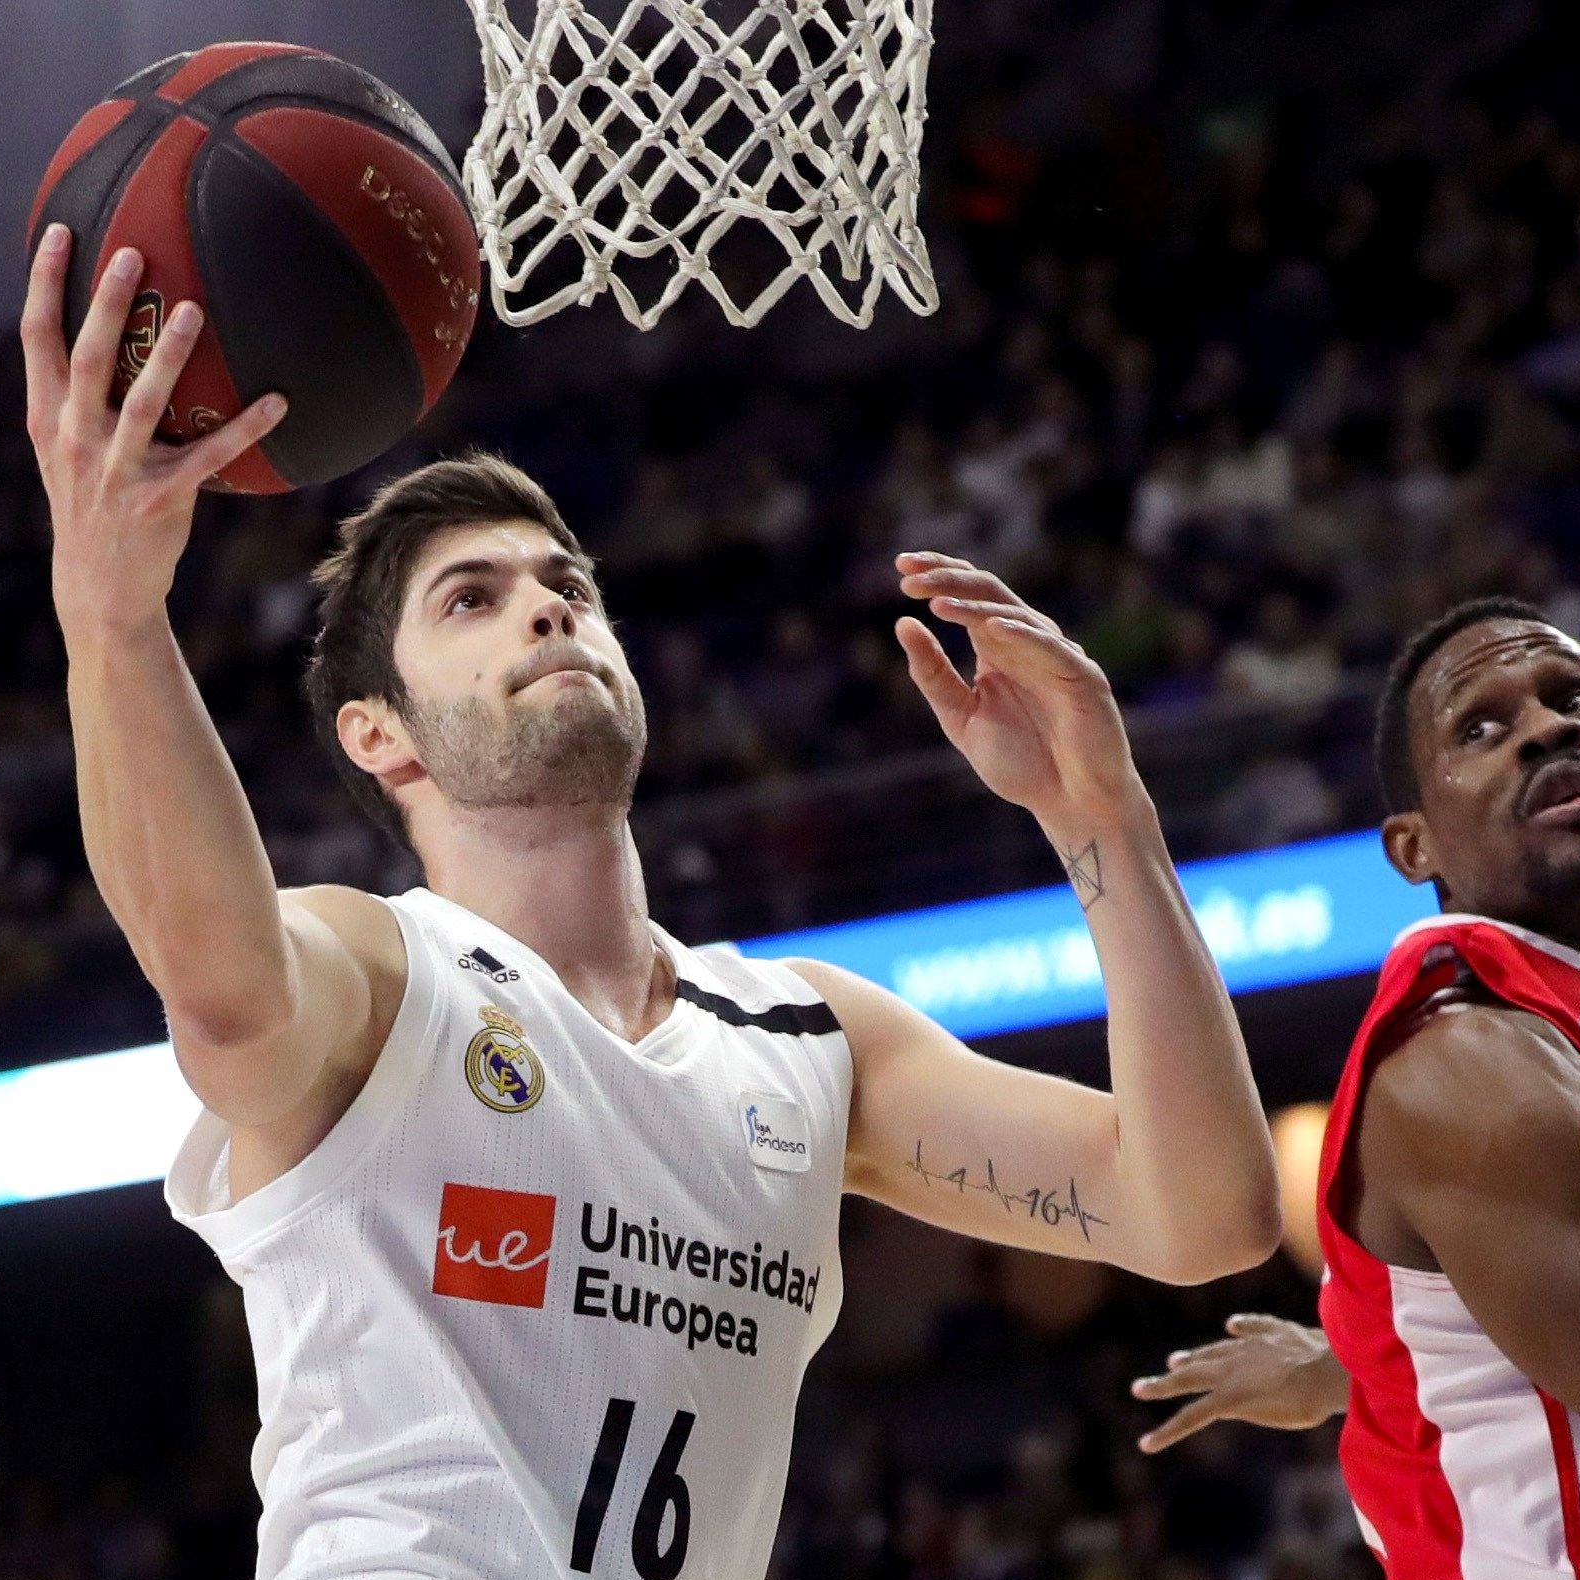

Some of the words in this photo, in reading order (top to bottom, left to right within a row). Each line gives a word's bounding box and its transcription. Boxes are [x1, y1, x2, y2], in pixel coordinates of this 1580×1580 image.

[457, 953, 521, 984] adas
[756, 1136, 807, 1155] endesa
[581, 1202, 821, 1314] Universidad
[573, 1266, 759, 1357] Europea
